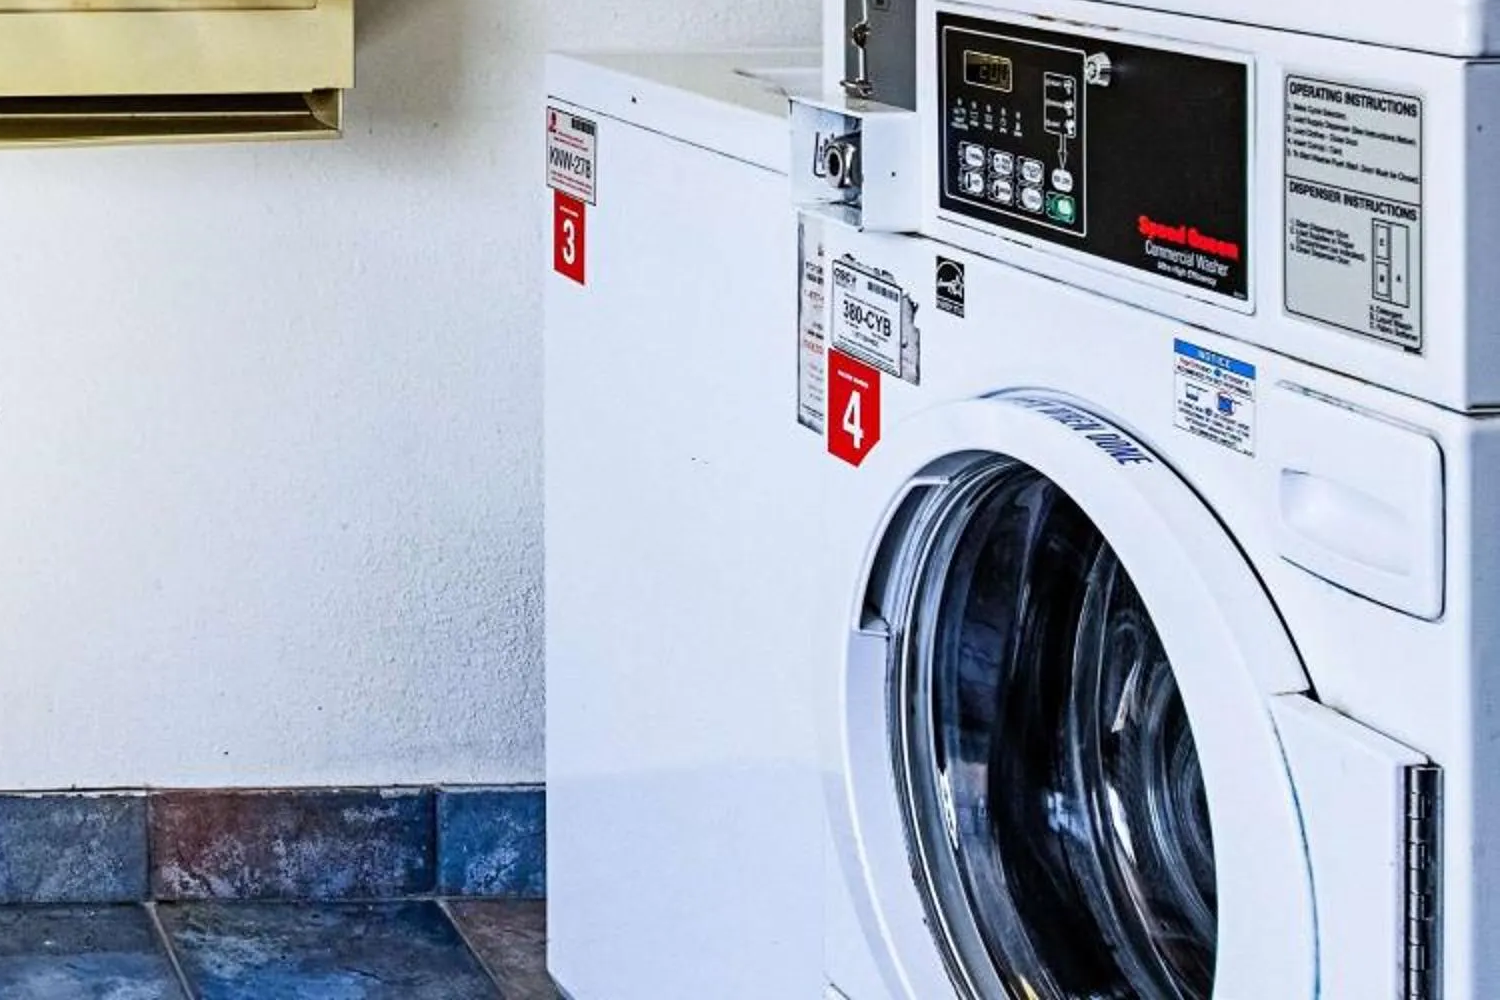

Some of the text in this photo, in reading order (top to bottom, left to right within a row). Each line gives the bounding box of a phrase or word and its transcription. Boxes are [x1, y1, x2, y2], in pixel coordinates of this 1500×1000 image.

[1289, 82, 1417, 117] OPERATING INSTRUCTIONS
[1290, 182, 1417, 220] DISPENSER INSTRUCTIONS
[563, 219, 575, 264] 3
[1145, 240, 1229, 277] Commercial Washer
[843, 300, 892, 337] 380-CYB
[842, 390, 864, 449] 4
